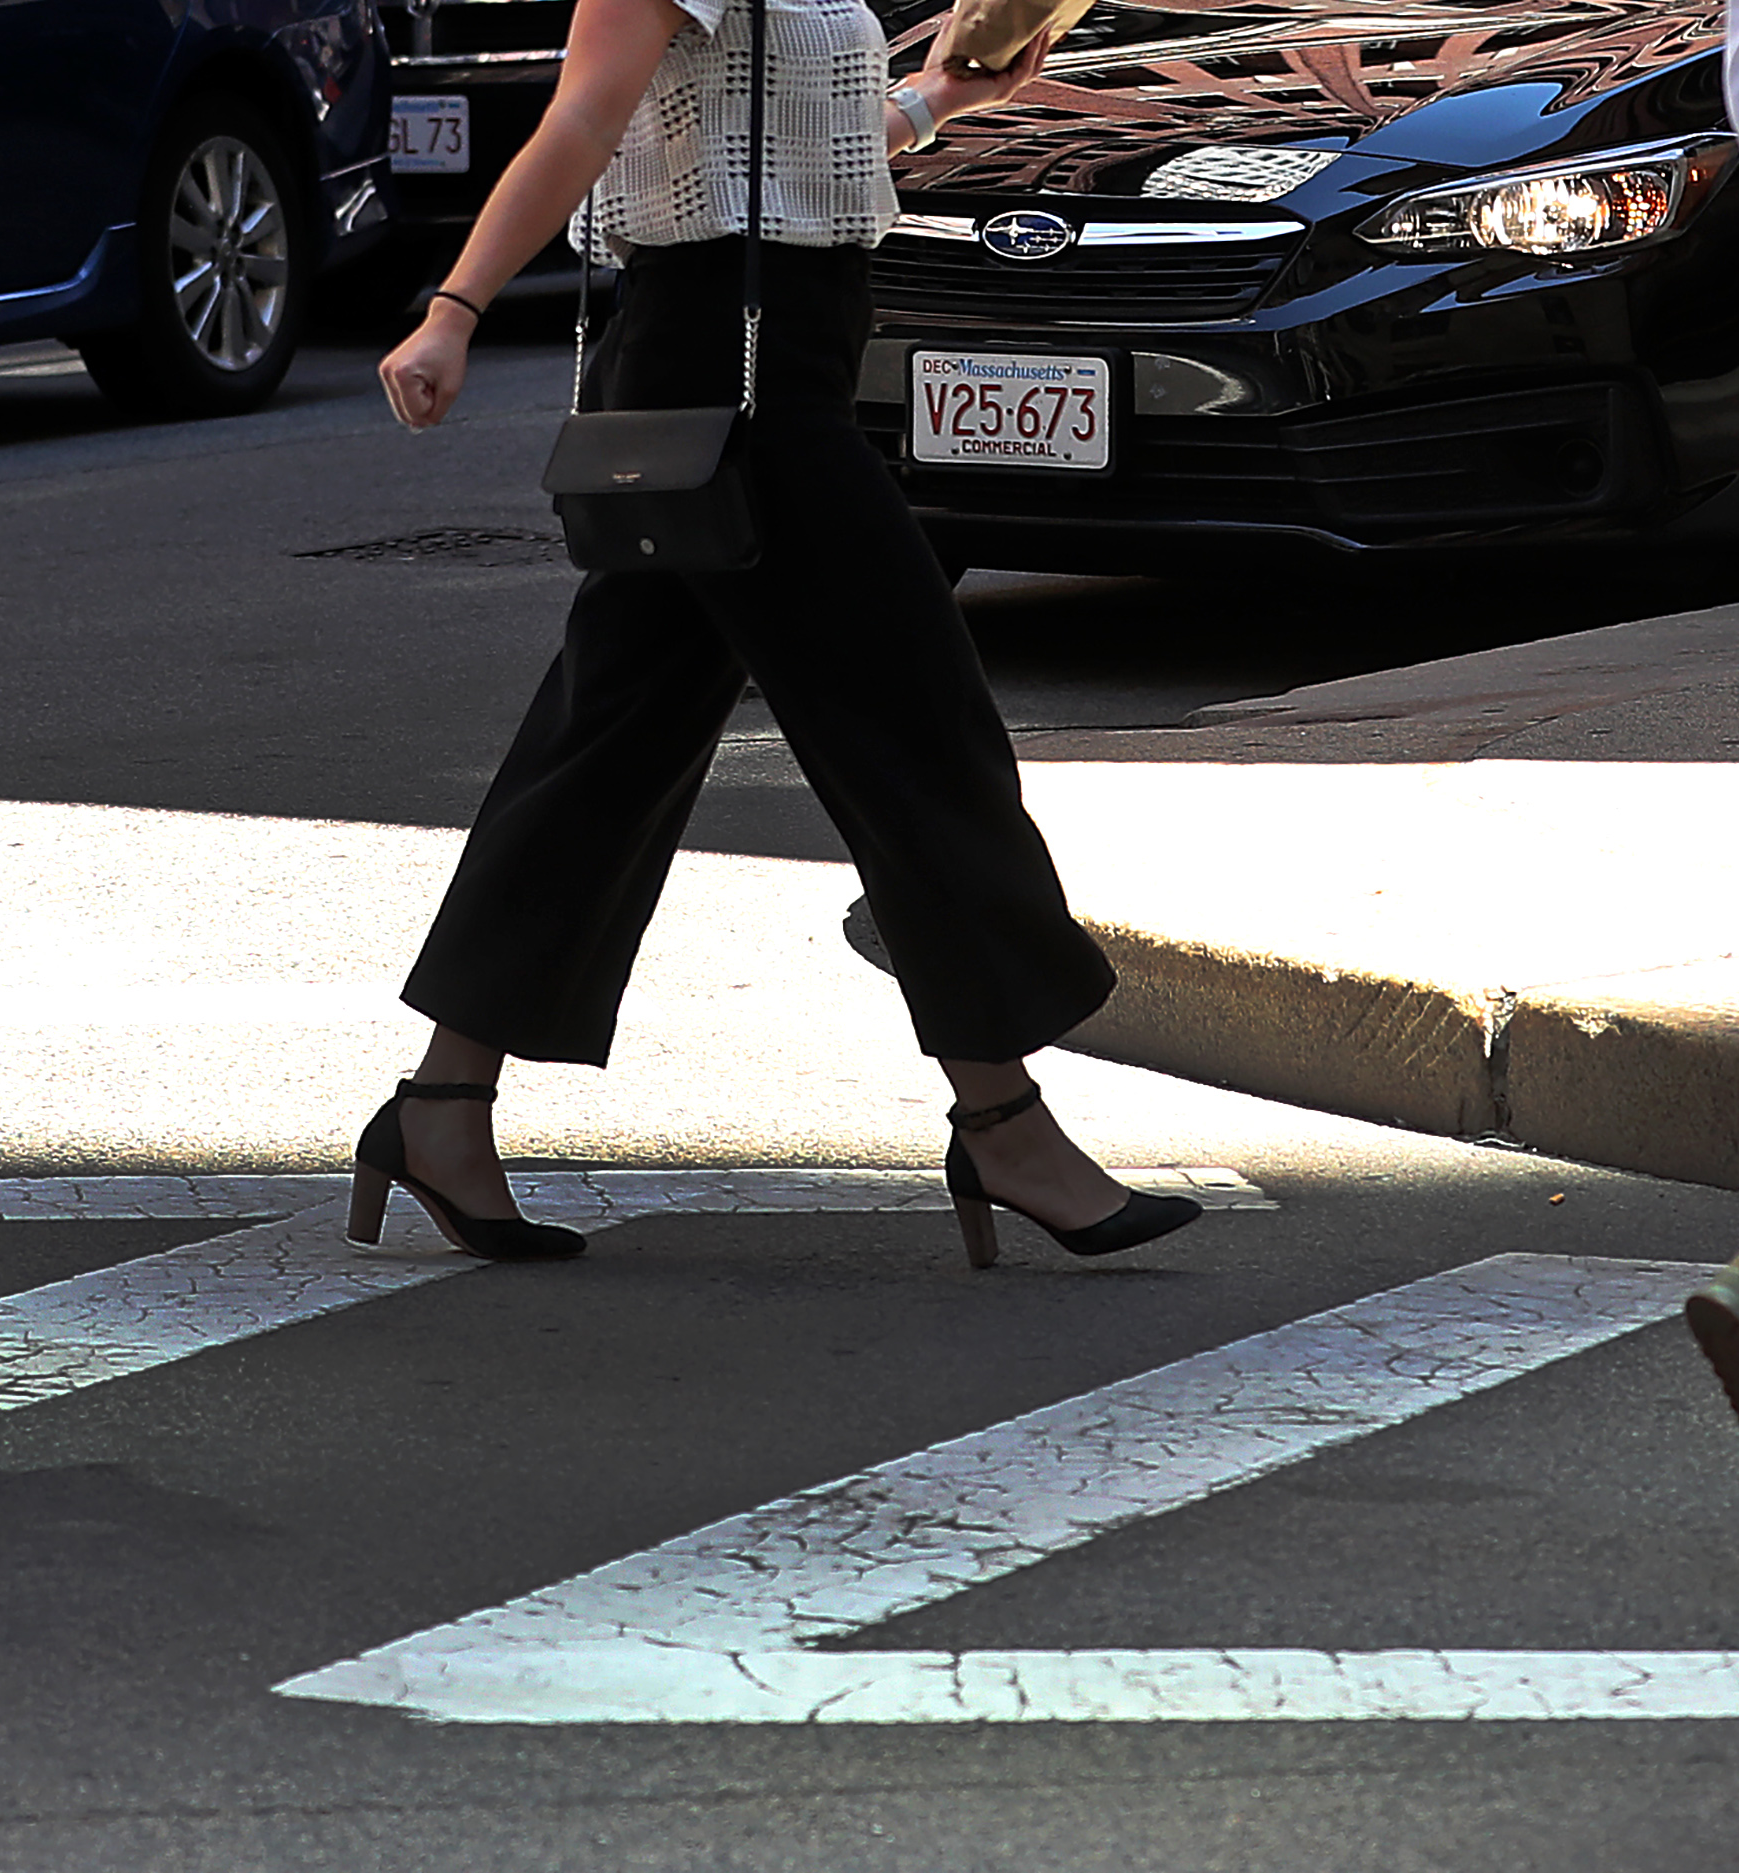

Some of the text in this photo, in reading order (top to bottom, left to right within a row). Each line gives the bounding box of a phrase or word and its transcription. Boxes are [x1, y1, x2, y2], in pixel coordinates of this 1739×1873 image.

[428, 117, 461, 154] 73
[922, 358, 1065, 380] DEC Massachusetts
[961, 439, 1057, 457] COMMERCIAL
